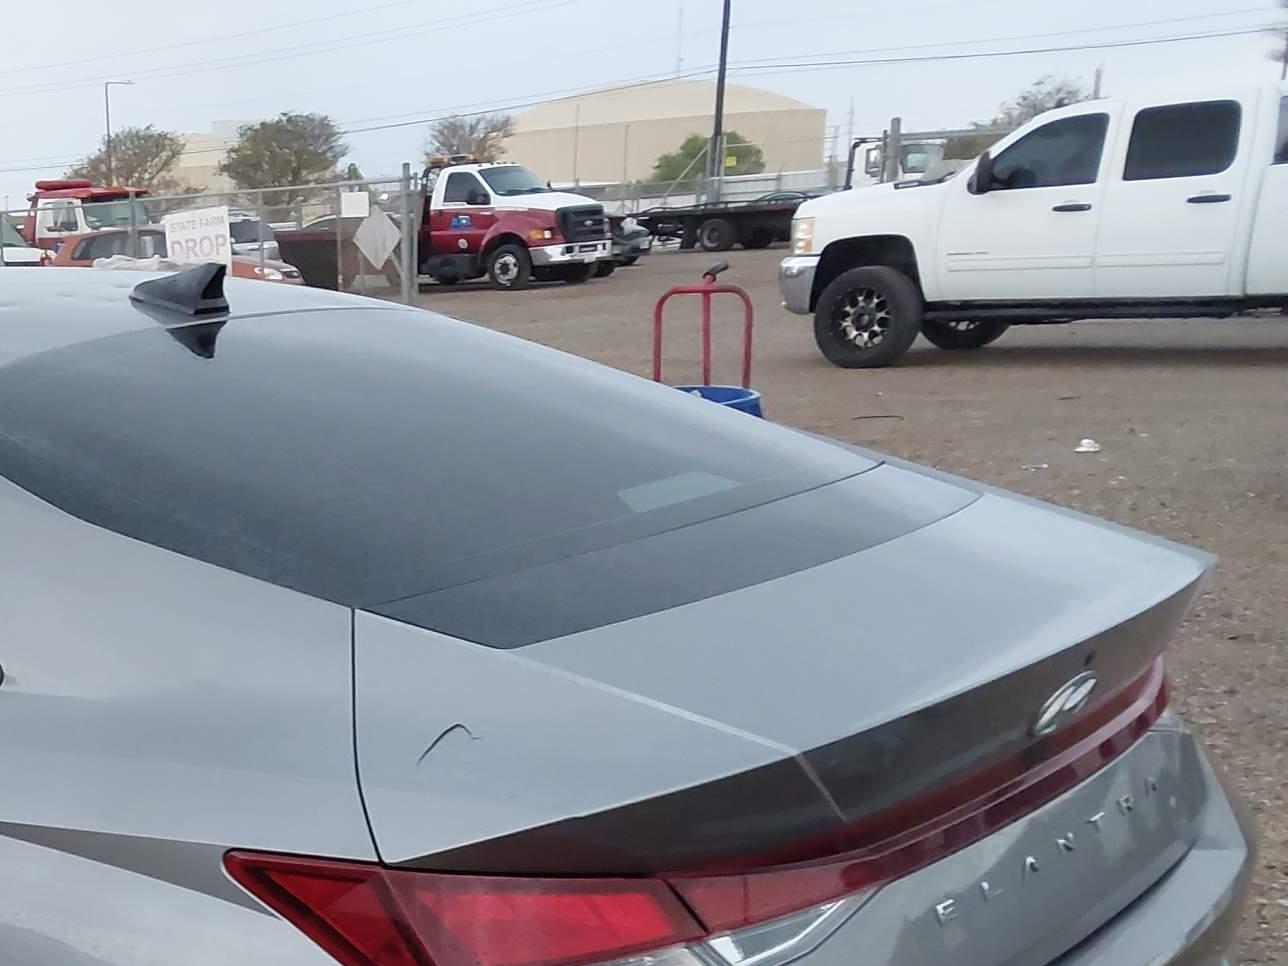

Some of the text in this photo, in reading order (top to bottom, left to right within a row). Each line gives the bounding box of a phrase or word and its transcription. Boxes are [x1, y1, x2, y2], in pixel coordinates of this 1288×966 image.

[170, 215, 225, 232] STATE FARM
[170, 234, 227, 259] DROP
[934, 776, 1159, 926] ELANTRA
